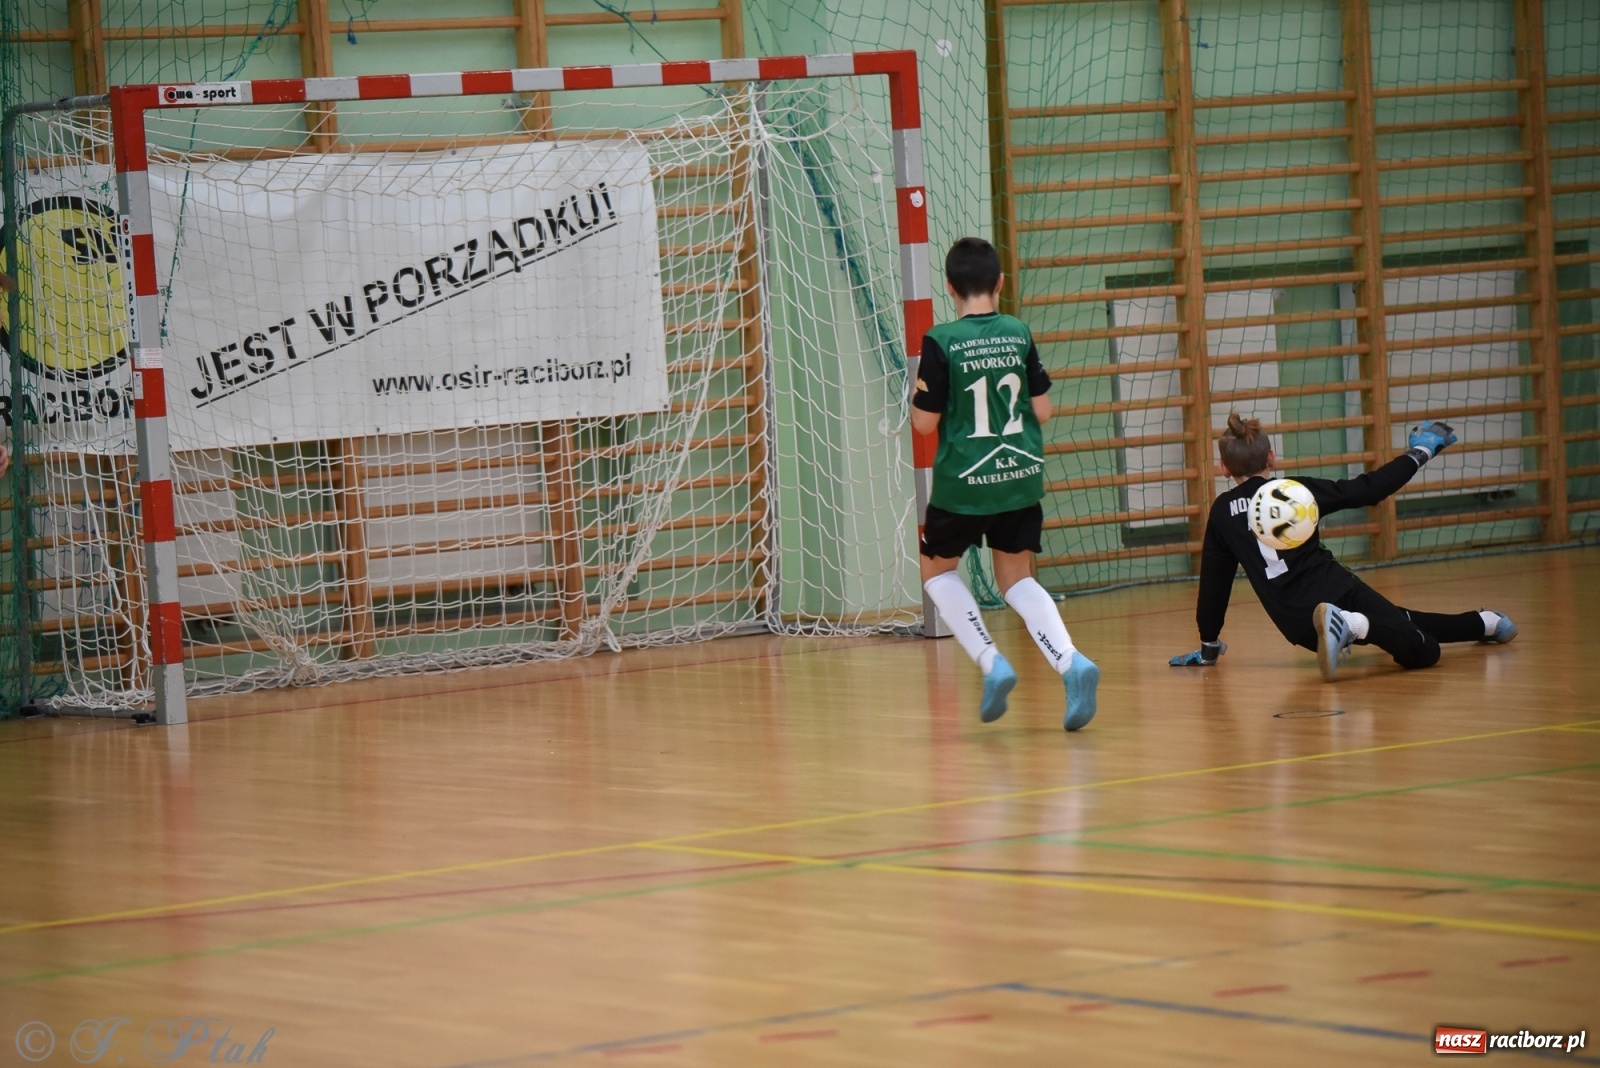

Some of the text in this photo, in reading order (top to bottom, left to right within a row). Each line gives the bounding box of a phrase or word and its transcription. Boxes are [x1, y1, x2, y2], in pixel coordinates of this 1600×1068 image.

[203, 87, 237, 101] sport
[190, 181, 617, 400] JEST W PORZĄDKU!
[127, 281, 137, 341] sport
[949, 338, 990, 352] AKADEMIA
[372, 352, 633, 397] www.osir-raciborz.pl
[964, 372, 1024, 439] 12
[967, 464, 1042, 486] BAUELEMENTE
[995, 456, 1018, 470] K.K
